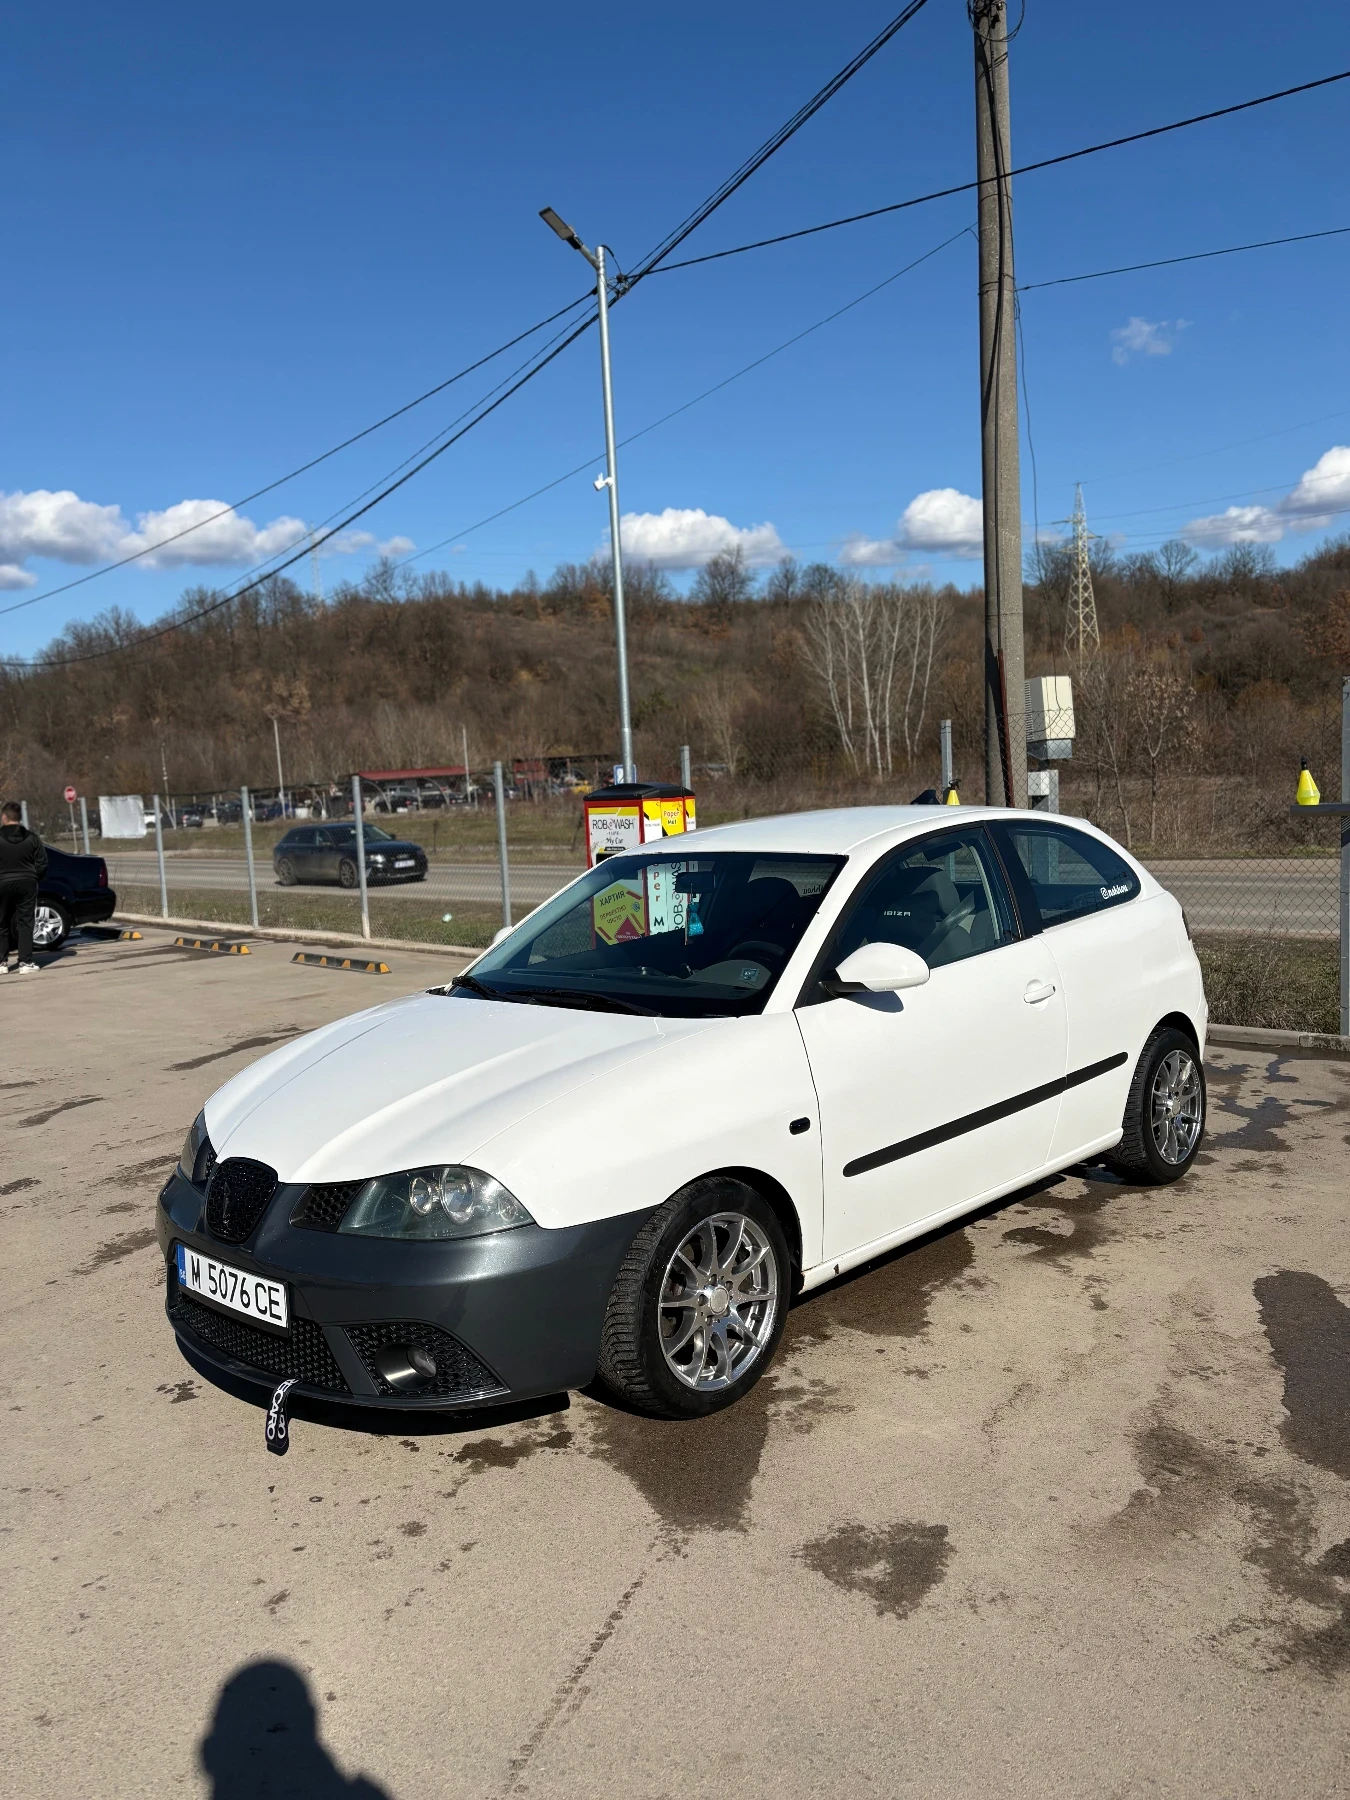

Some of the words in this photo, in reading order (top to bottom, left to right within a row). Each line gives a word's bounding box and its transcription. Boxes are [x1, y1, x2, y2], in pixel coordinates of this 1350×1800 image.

[599, 890, 626, 907] ХАРТИЯ
[191, 1254, 202, 1290] M
[208, 1262, 251, 1309] 5076
[254, 1281, 283, 1322] CE
[267, 1378, 299, 1440] RECARO
